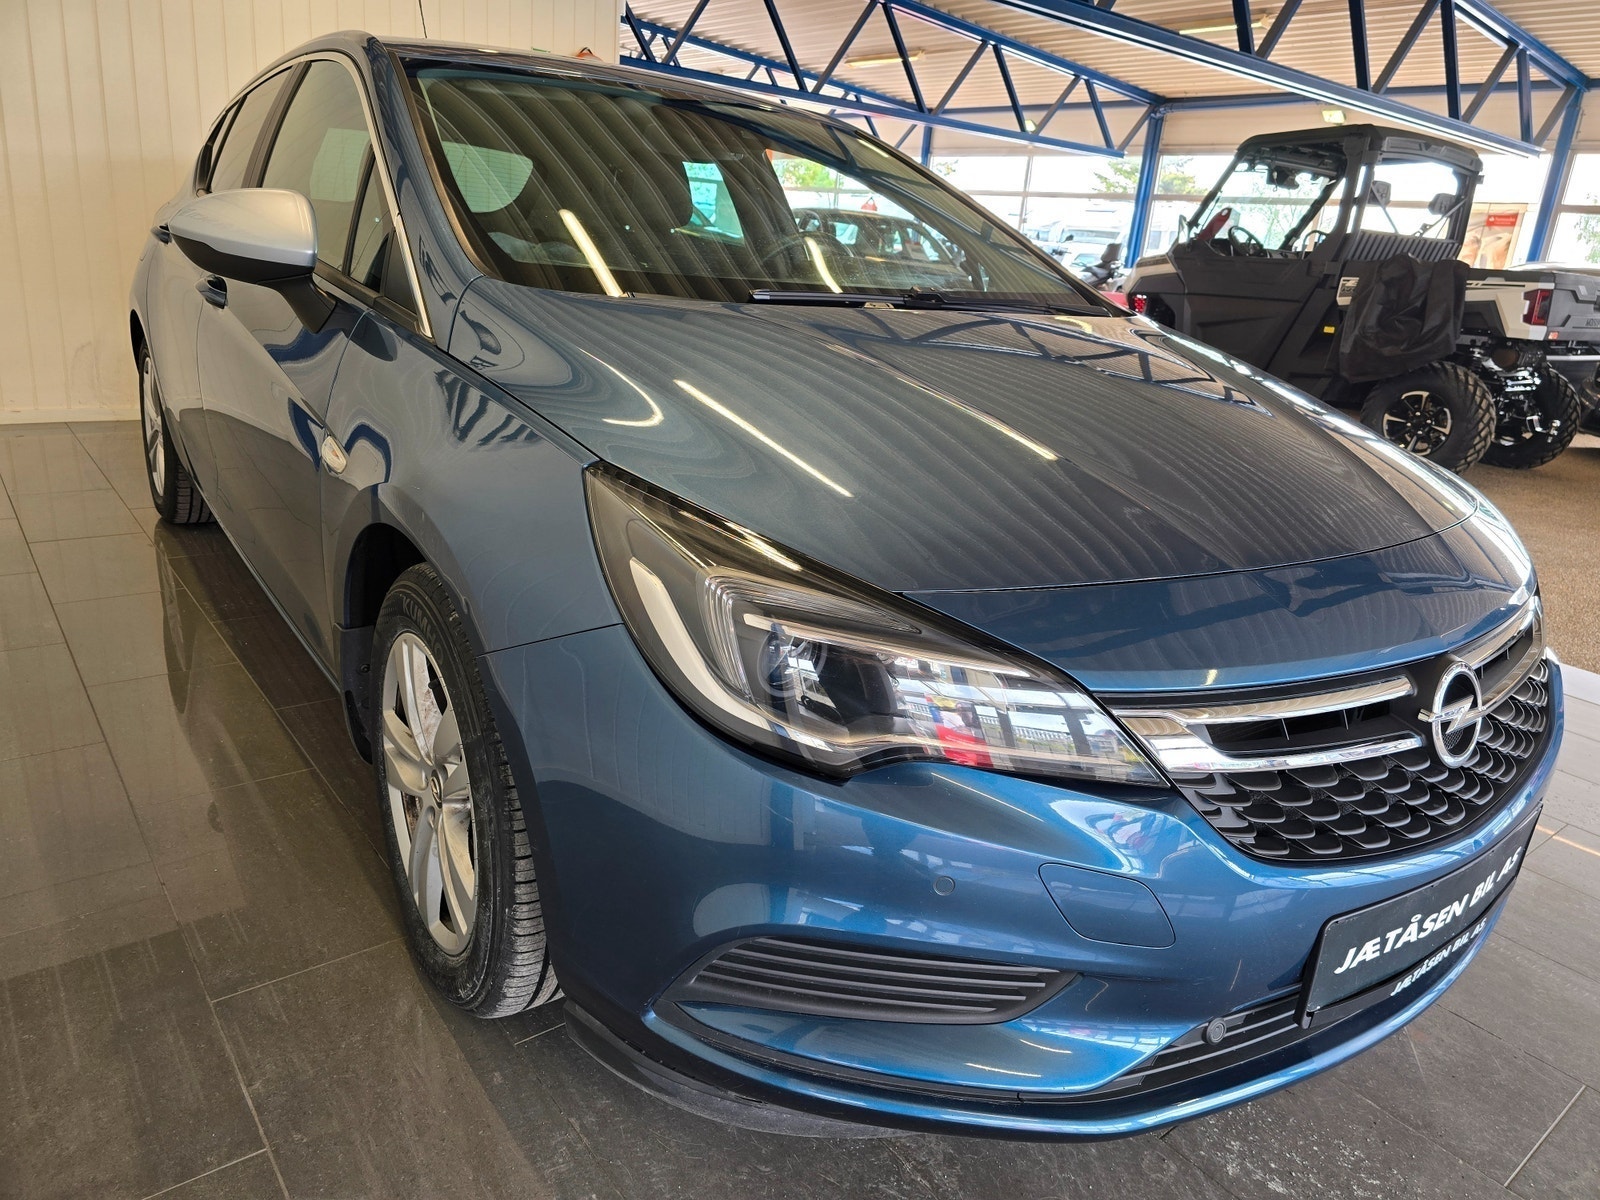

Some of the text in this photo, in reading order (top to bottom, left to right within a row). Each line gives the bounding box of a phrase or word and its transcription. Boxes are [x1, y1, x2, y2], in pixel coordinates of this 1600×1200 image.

[402, 595, 444, 664] KUMHO
[1334, 846, 1522, 974] JÆTÅSEN BIL AS
[1390, 945, 1453, 996] JÆTÅSEN
[1452, 934, 1470, 953] BIL
